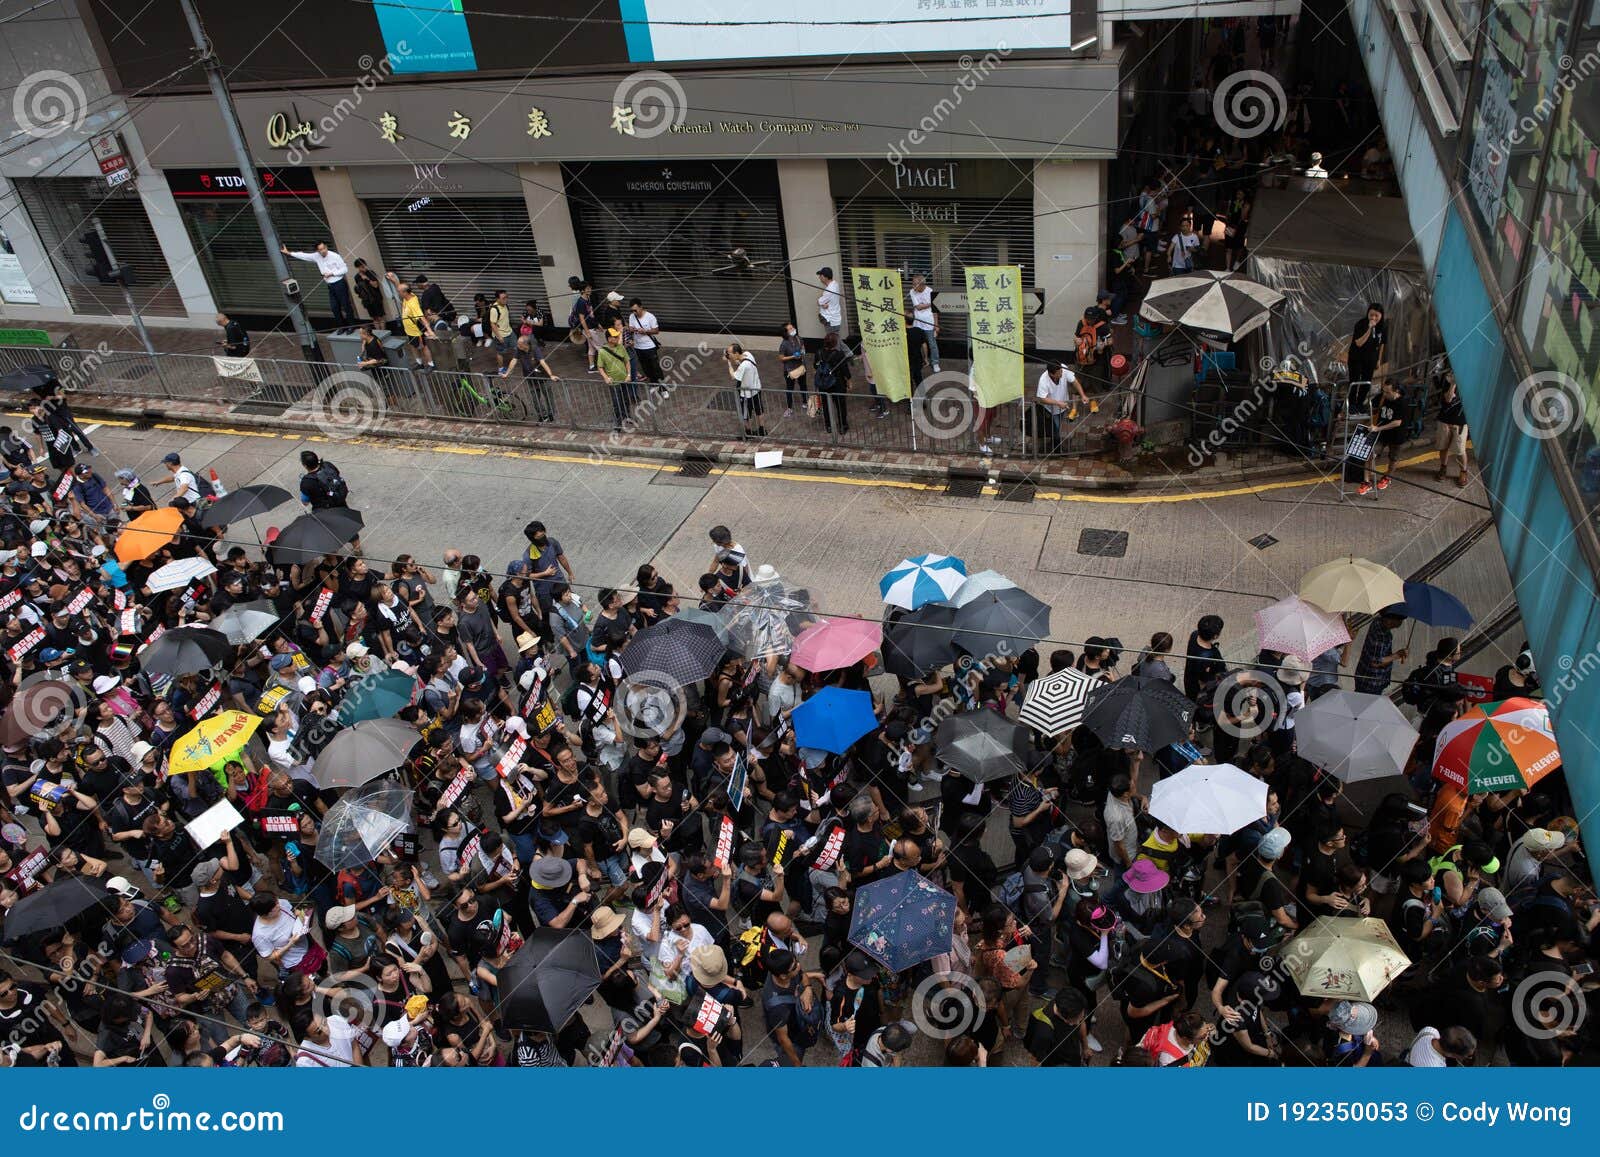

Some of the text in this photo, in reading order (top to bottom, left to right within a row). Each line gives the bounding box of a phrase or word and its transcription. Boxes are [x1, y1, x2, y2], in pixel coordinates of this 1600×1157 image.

[669, 122, 713, 134] Oriental
[720, 122, 754, 133] Watch
[760, 121, 814, 136] Company
[414, 164, 447, 180] IWC
[215, 176, 247, 188] TUD
[1121, 734, 1137, 744] EA
